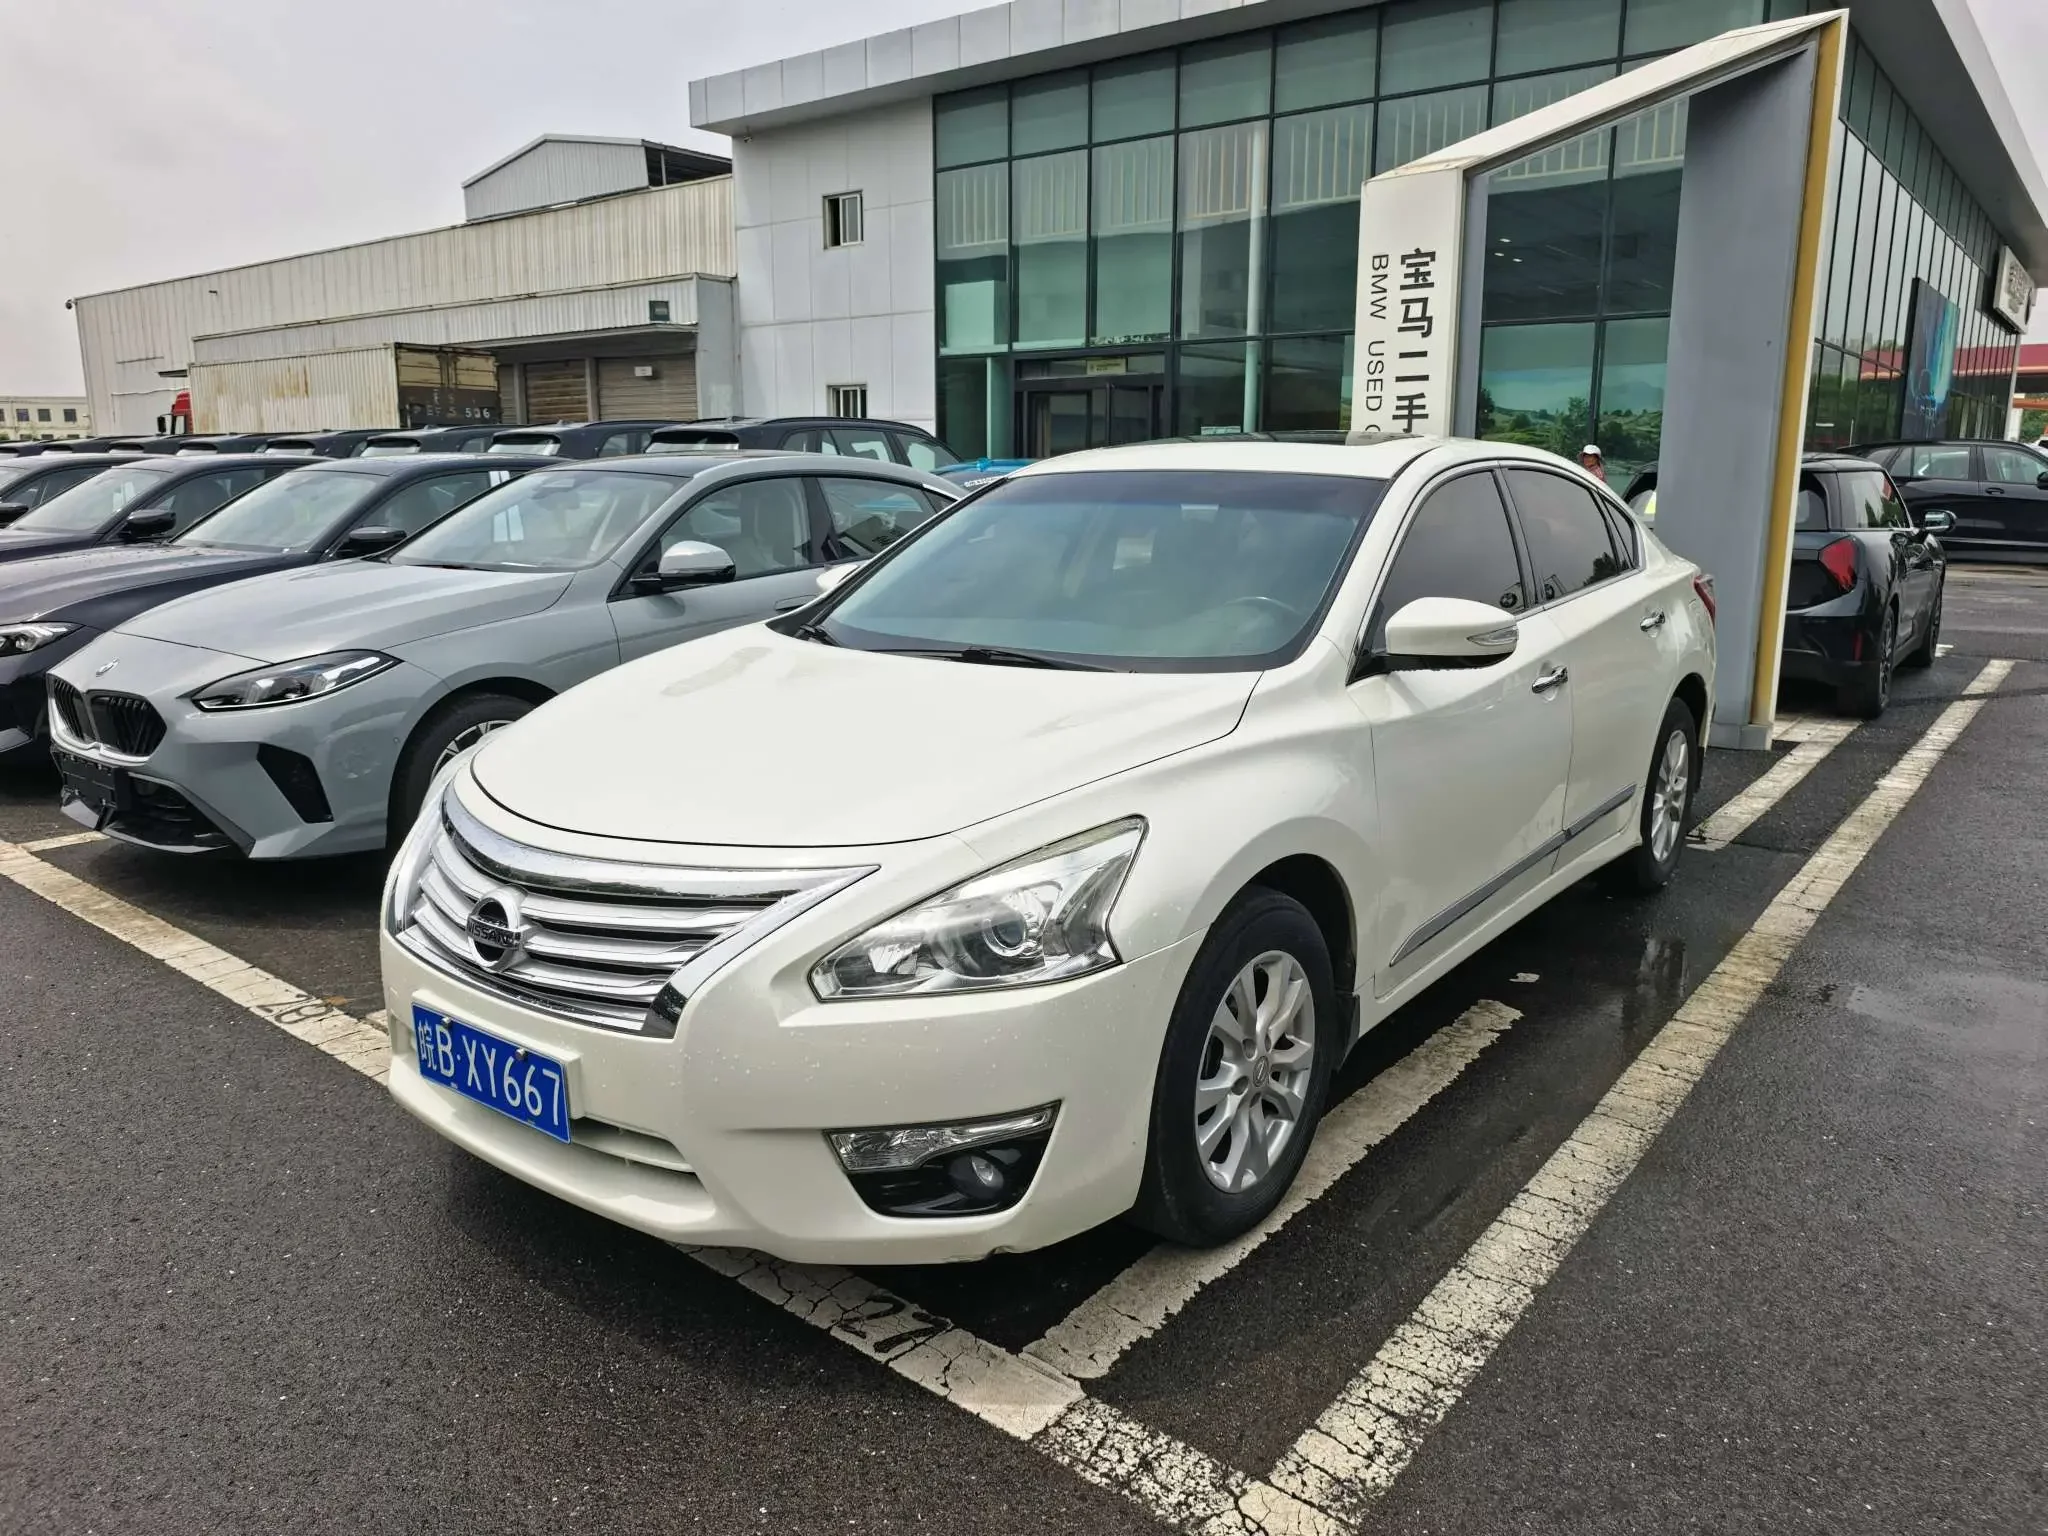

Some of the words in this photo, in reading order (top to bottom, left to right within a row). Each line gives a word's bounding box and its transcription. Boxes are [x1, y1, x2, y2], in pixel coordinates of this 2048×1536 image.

[1370, 254, 1389, 320] BMW
[1392, 248, 1436, 432] 宝马二手
[1366, 340, 1385, 412] USED
[467, 920, 511, 946] NISSAN
